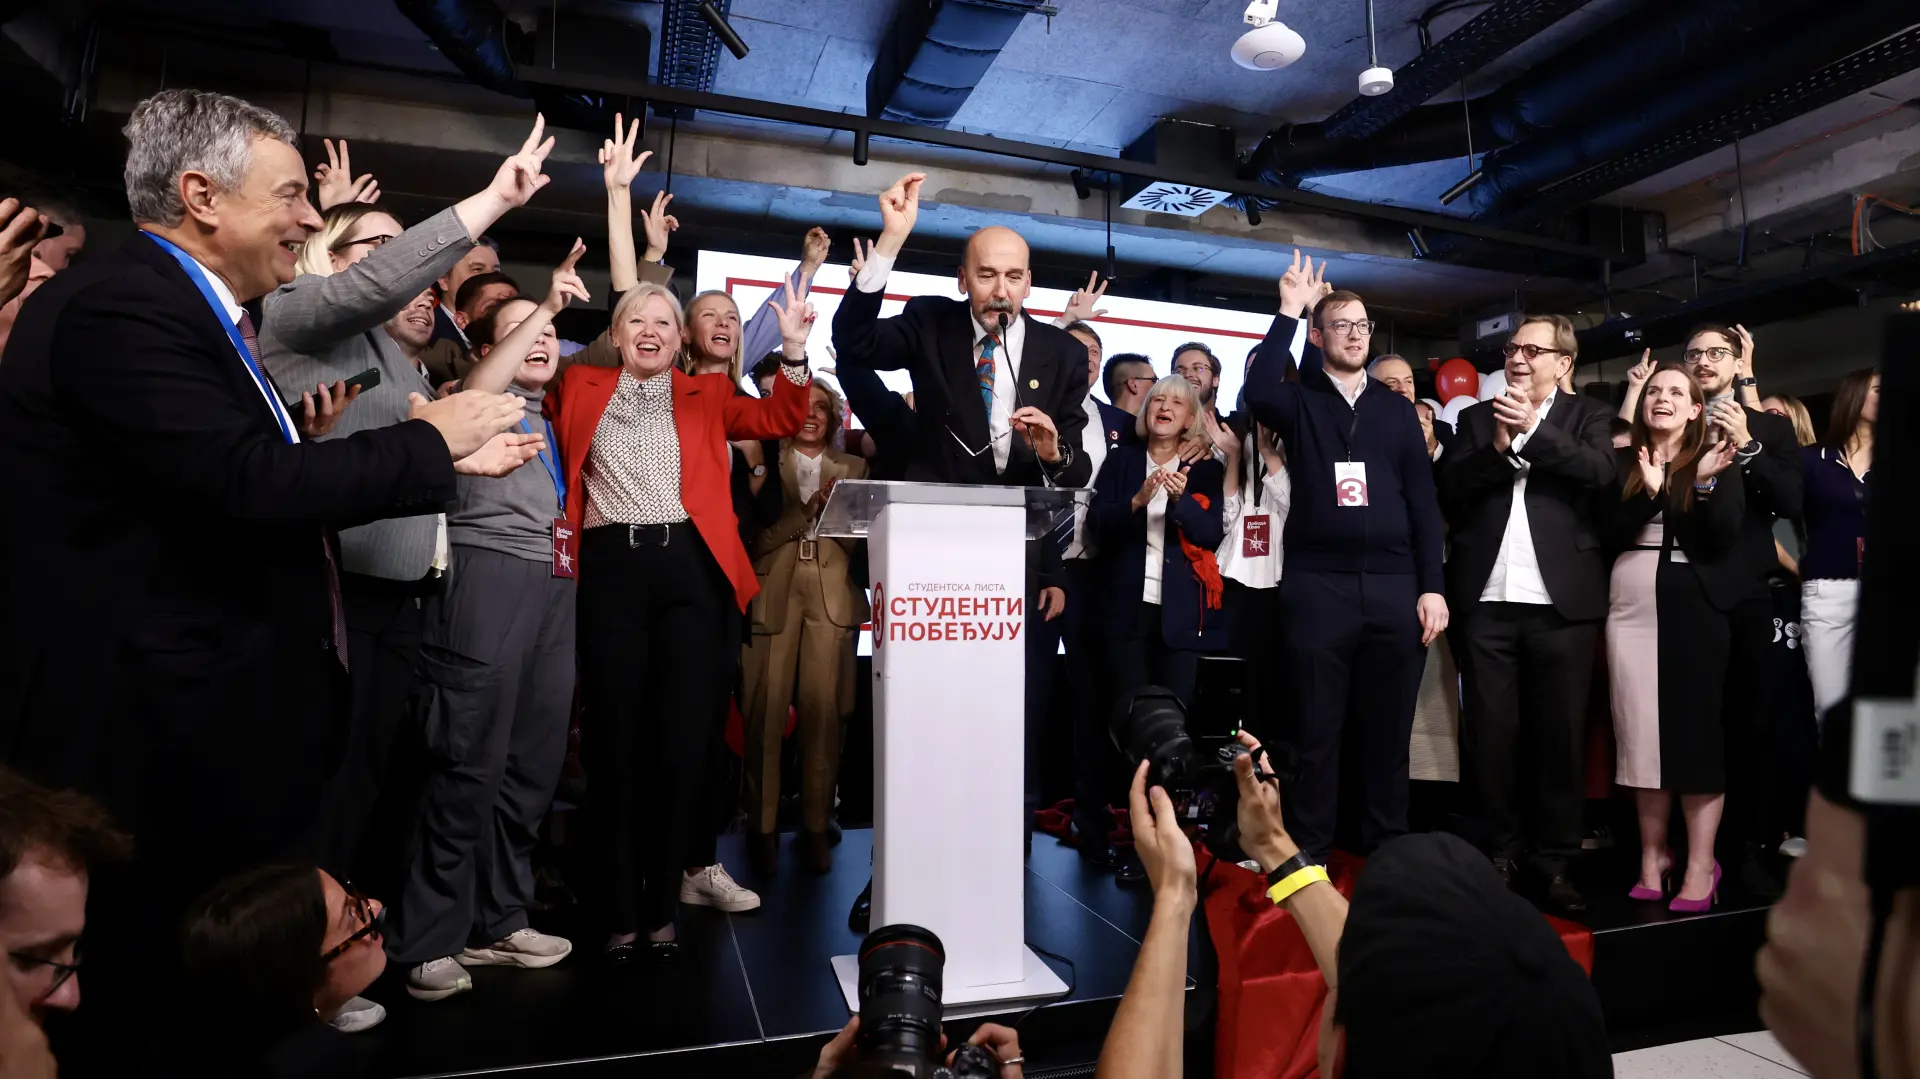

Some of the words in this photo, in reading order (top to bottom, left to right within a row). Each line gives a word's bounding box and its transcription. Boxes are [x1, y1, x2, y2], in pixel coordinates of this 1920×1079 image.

[1111, 430, 1118, 440] 3
[1341, 481, 1364, 506] 3
[908, 583, 971, 592] СТУДЕНТСКА
[974, 583, 1006, 592] ЛИСТА
[874, 589, 883, 632] 3
[890, 597, 1023, 619] СТУДЕНТИ
[890, 622, 1022, 641] ПОБЕЂУЈУ
